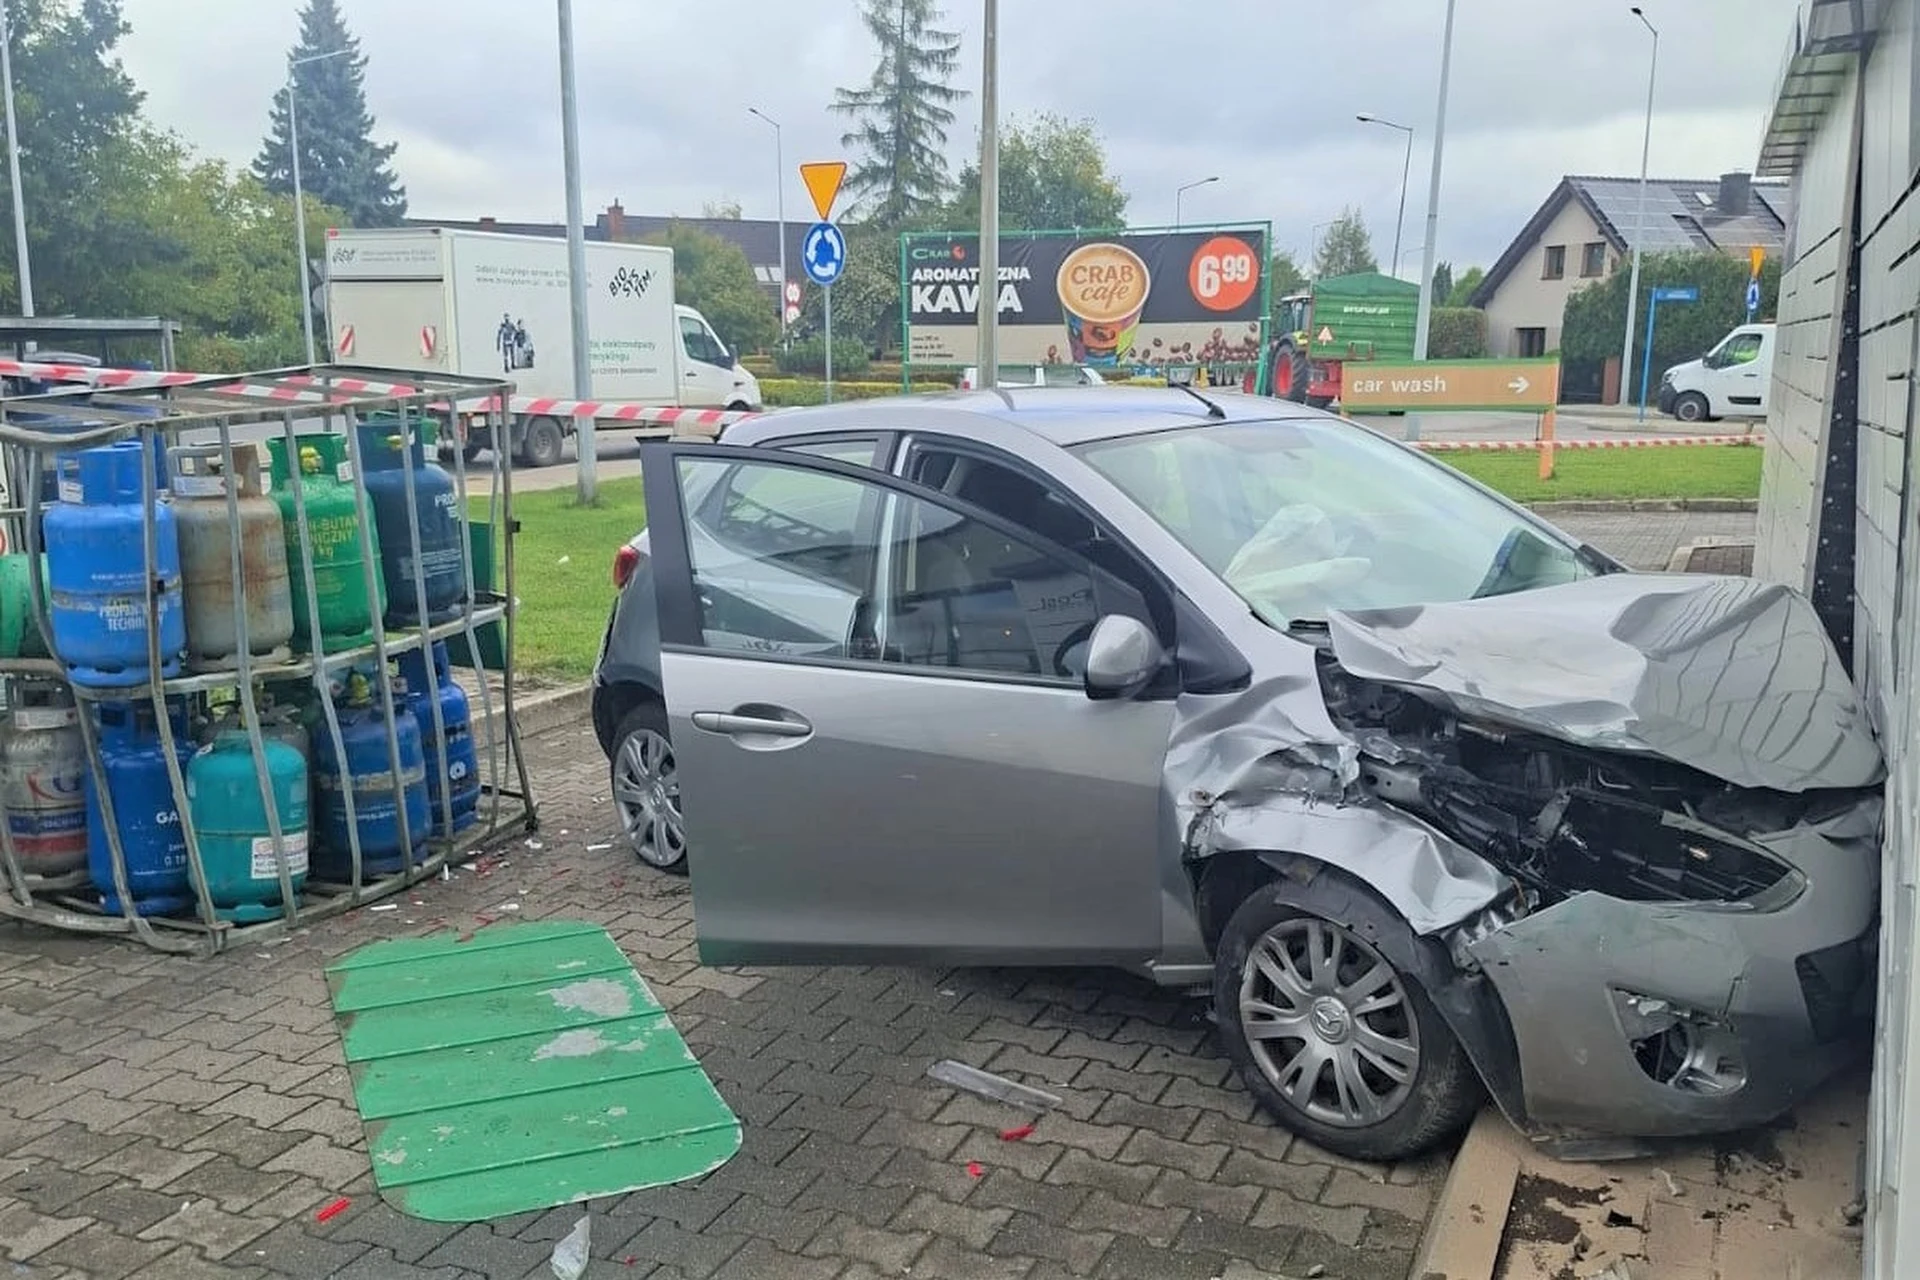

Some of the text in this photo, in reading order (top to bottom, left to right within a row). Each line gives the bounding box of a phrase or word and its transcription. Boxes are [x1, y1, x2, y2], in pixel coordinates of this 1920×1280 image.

[912, 266, 1032, 282] AROMATZNA
[1071, 265, 1134, 285] CRAB
[1353, 375, 1447, 394] car wash
